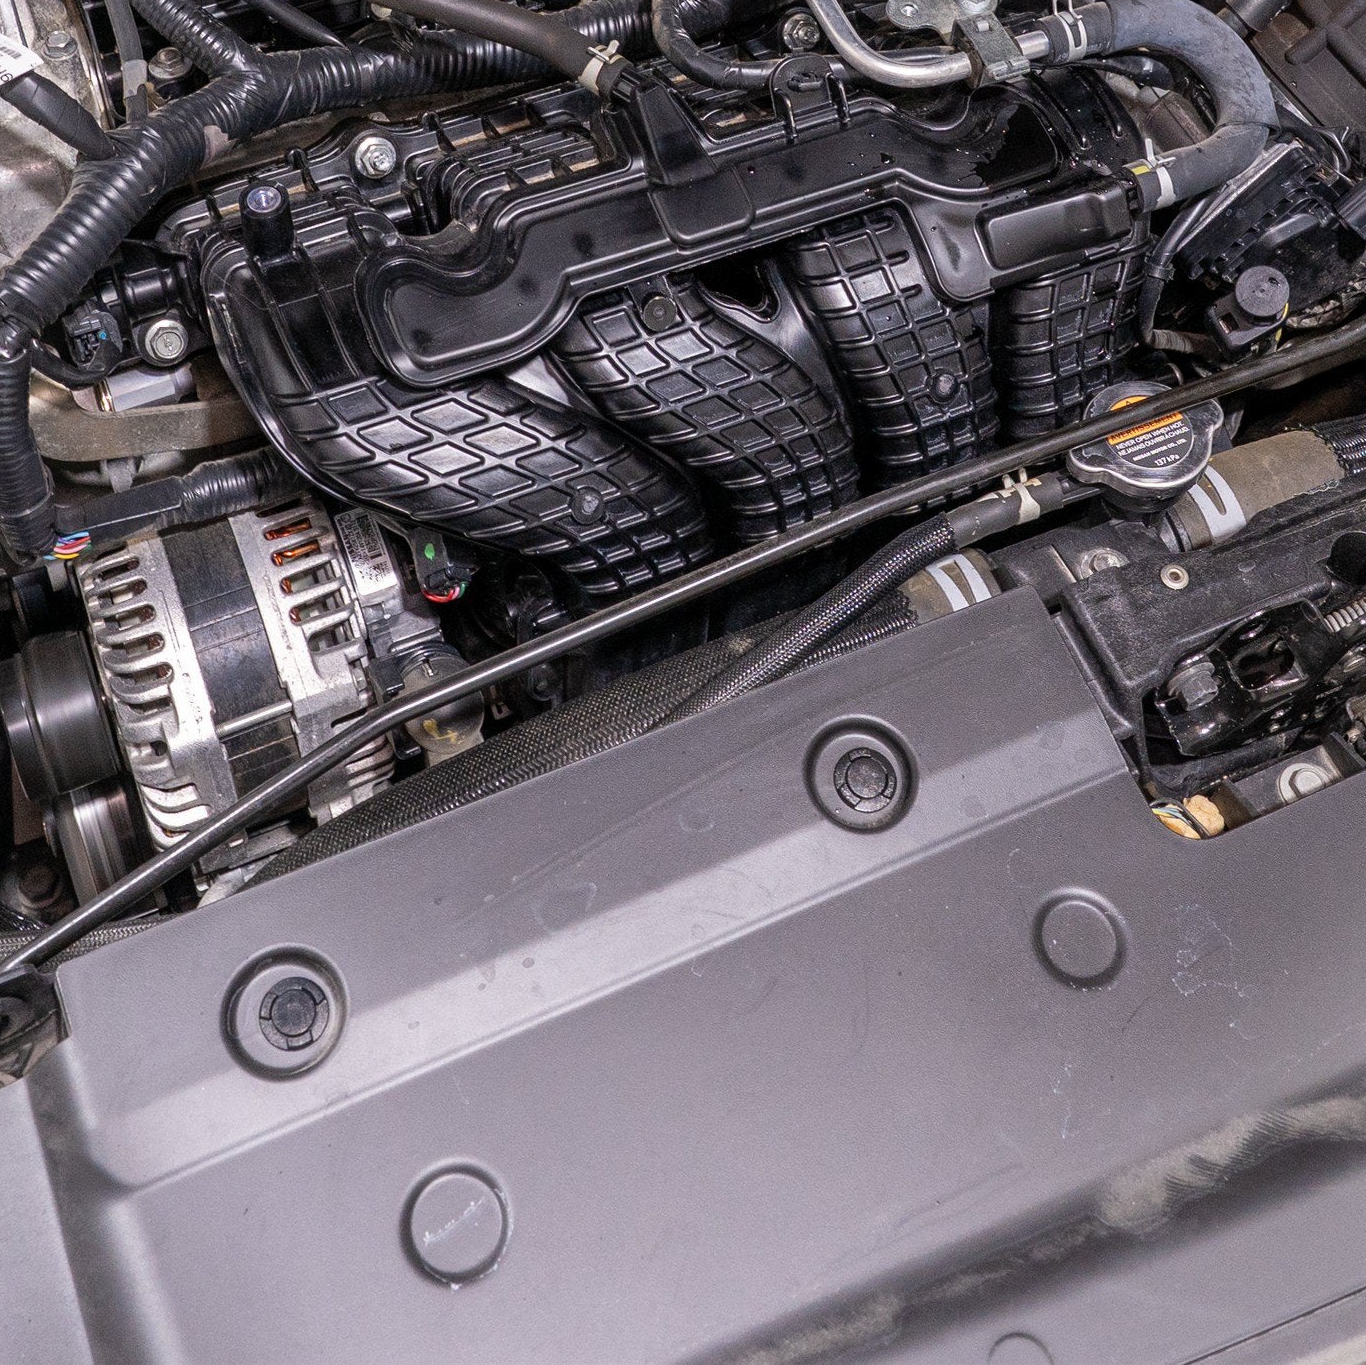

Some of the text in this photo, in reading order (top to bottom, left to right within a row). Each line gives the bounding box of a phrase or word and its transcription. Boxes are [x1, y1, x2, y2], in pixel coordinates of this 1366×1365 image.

[1116, 439, 1136, 450] NEVER
[1135, 433, 1152, 443] OPEN
[1151, 426, 1171, 437] WHEN
[1133, 452, 1151, 461] NISSAN
[1150, 445, 1168, 455] MOTOR
[1167, 454, 1180, 462] kPa
